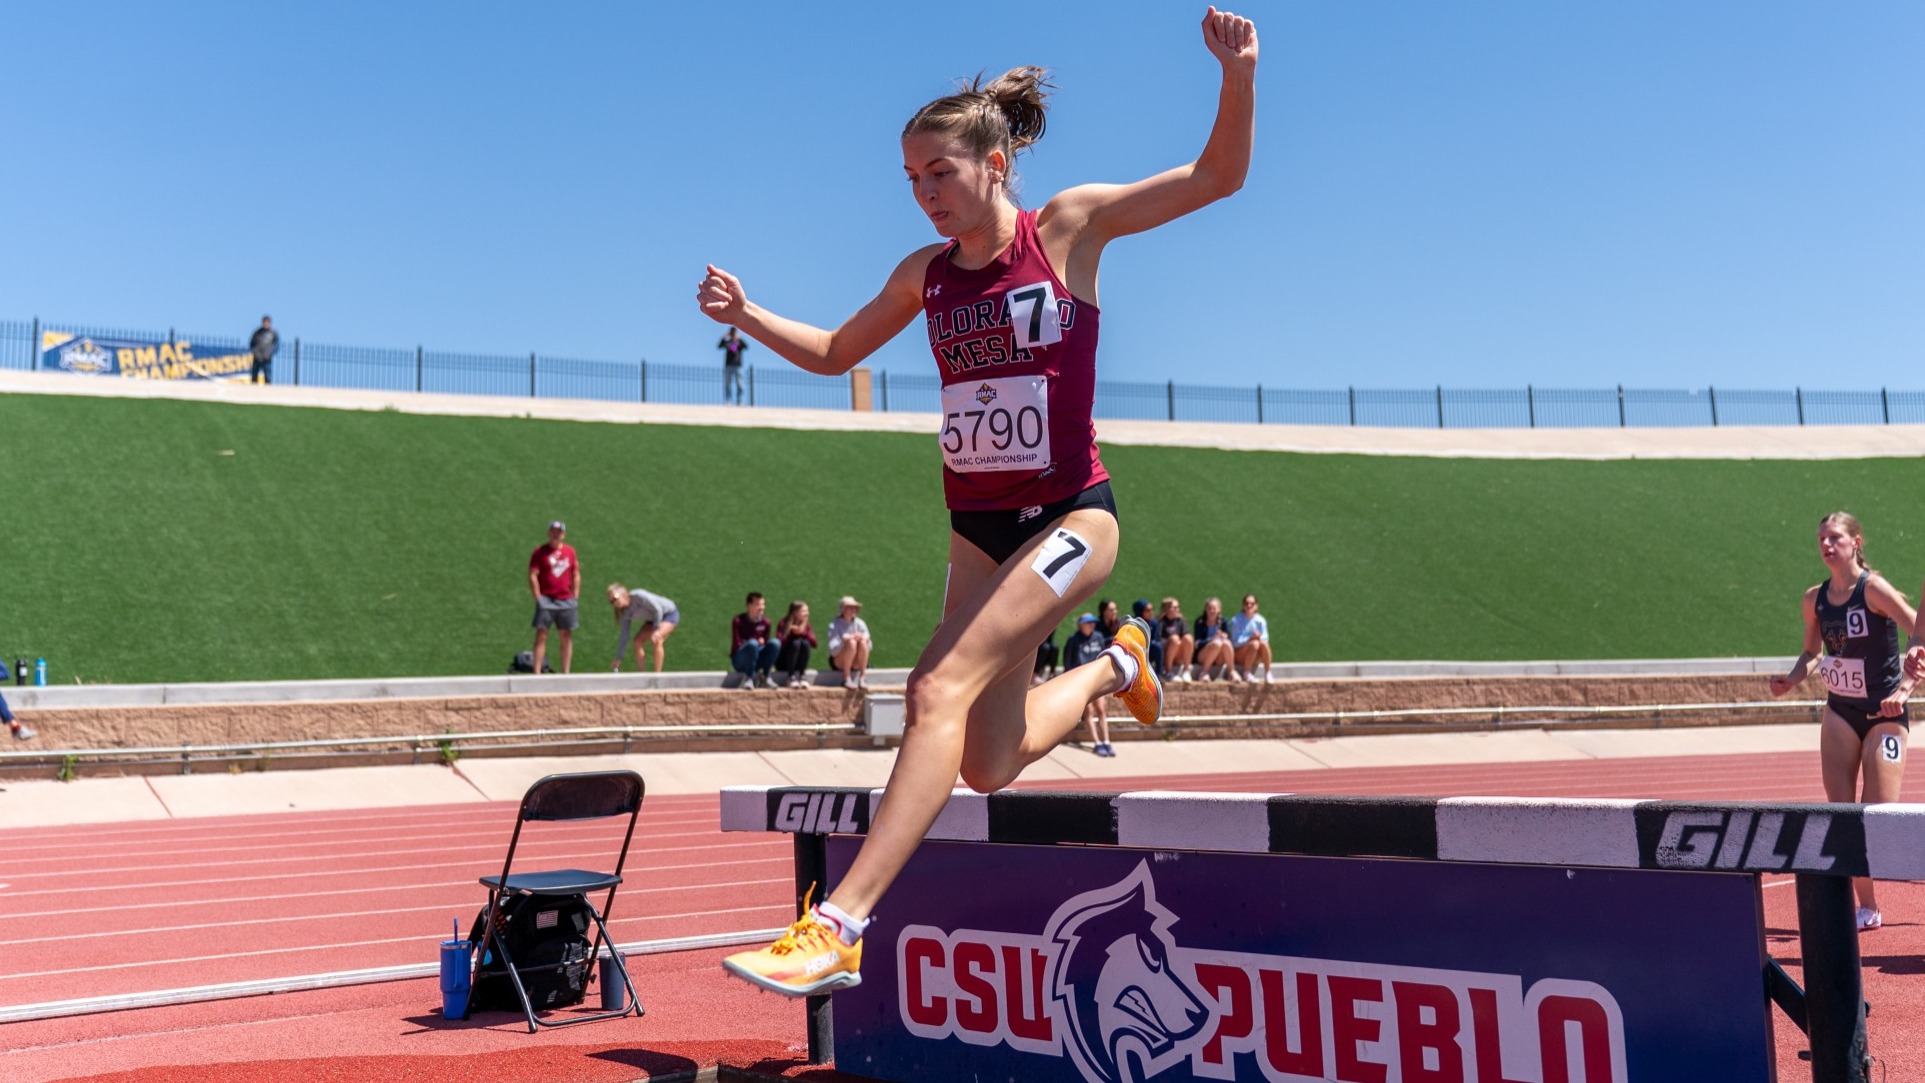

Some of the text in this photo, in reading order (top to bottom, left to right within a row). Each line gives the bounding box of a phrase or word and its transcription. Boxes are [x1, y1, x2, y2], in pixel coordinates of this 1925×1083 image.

[927, 296, 1077, 349] OLORAO
[1013, 286, 1047, 344] 7
[117, 341, 192, 371] RMAC
[120, 353, 254, 380] CHAMPIONSHI
[939, 333, 1034, 375] MESA
[977, 389, 996, 399] RMAC
[943, 405, 1043, 454] 5790
[951, 453, 1038, 467] RMAC CHAMPIONSHIP
[1043, 531, 1086, 580] 7
[1849, 612, 1864, 635] 9
[1821, 667, 1863, 689] 6015
[1885, 736, 1899, 760] 9
[775, 793, 858, 833] GILL
[1656, 811, 1836, 870] GILL
[805, 950, 840, 976] HOKA
[904, 937, 1614, 1083] CSU PUEBLO
